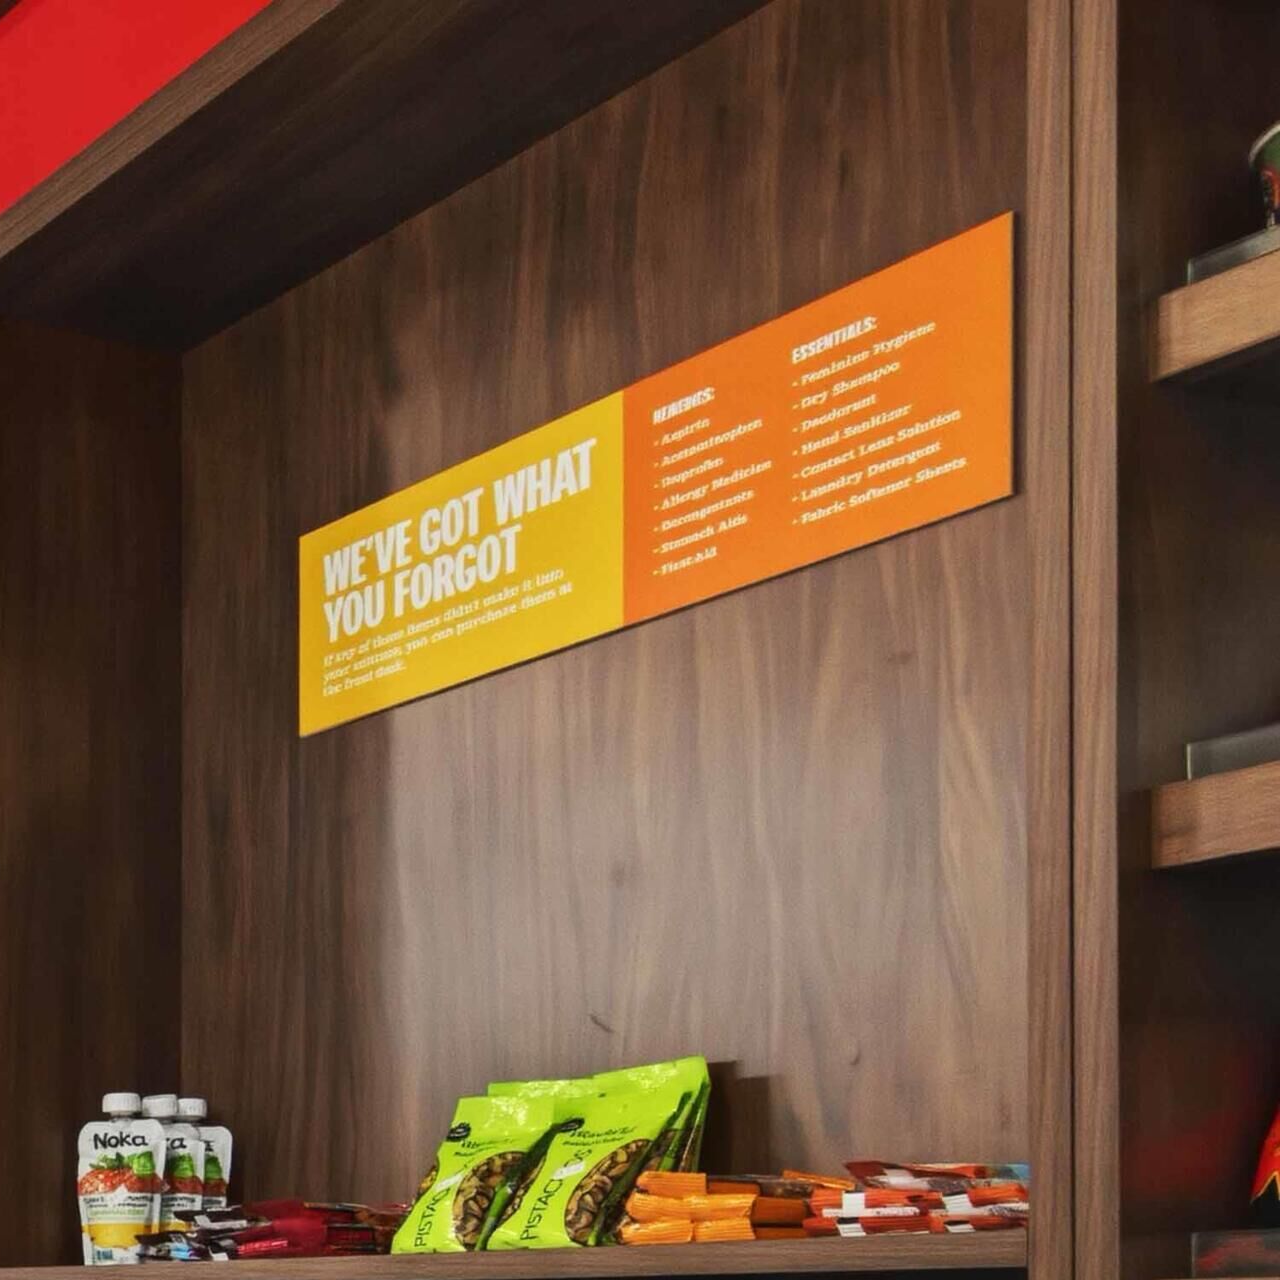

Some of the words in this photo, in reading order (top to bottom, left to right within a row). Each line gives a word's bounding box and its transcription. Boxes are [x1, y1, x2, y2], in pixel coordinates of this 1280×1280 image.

[323, 519, 412, 596] WE'VE
[420, 487, 483, 555] GOT
[493, 437, 597, 525] WHAT
[323, 580, 384, 643] YOU
[394, 524, 522, 618] FORGOT
